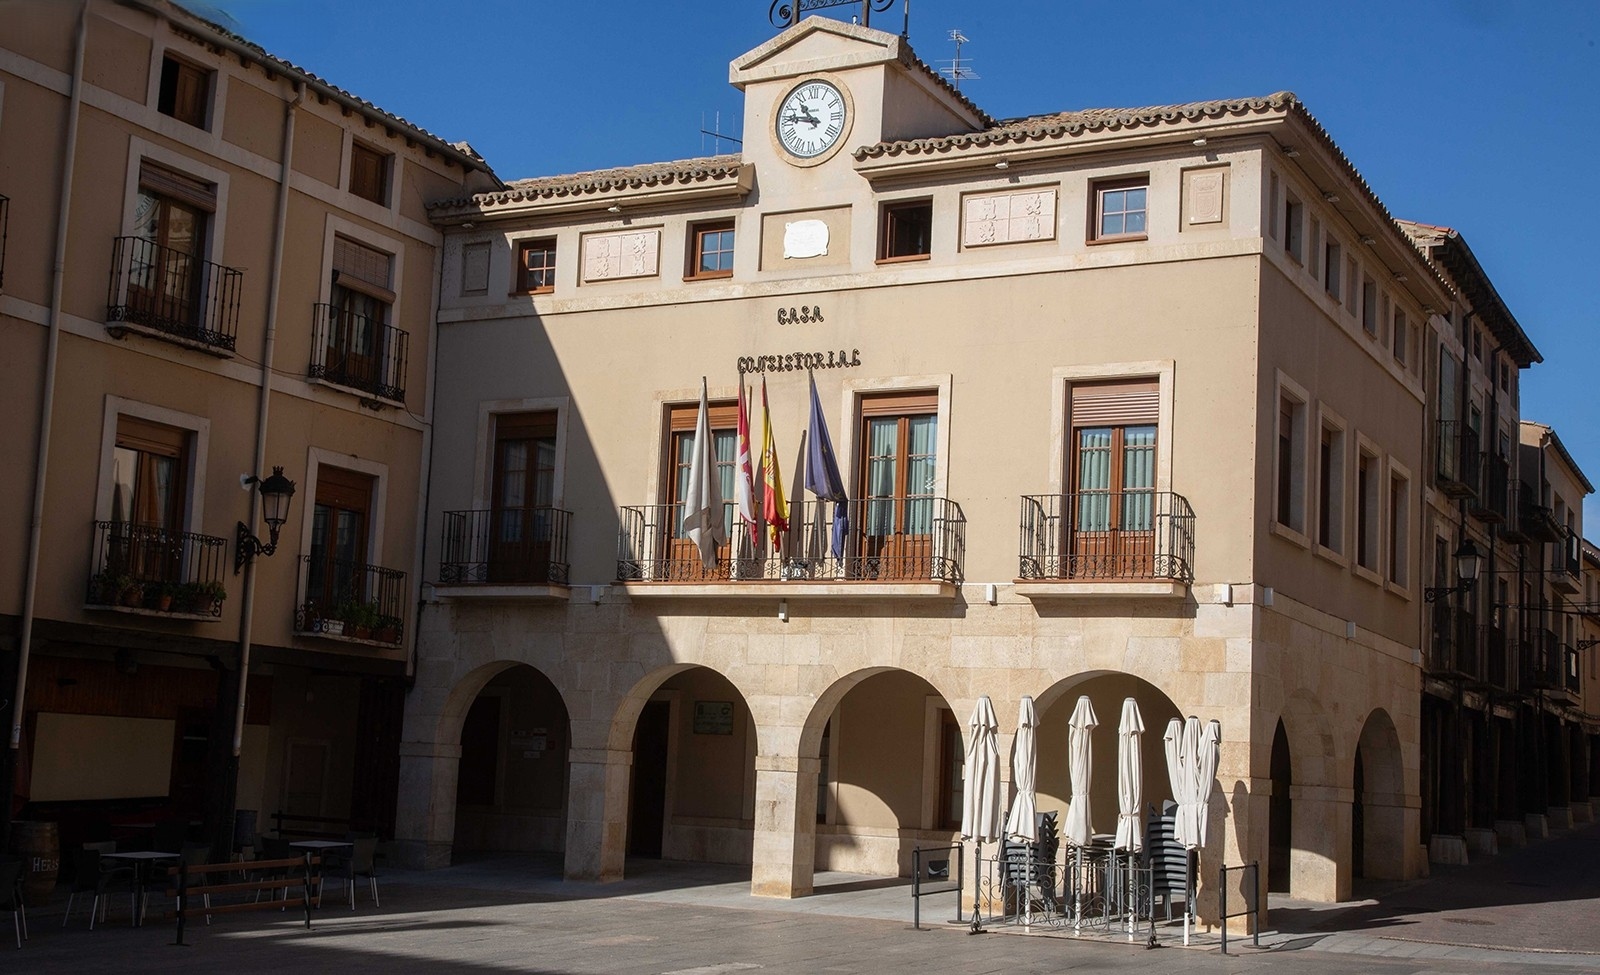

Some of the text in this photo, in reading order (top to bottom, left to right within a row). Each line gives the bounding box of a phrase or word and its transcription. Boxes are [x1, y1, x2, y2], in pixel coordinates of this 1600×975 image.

[808, 88, 819, 100] XII
[828, 98, 840, 109] II
[830, 111, 841, 121] III
[785, 127, 798, 145] VIII
[824, 124, 838, 138] IIII
[794, 137, 806, 152] VII
[819, 137, 828, 148] V
[777, 305, 825, 325] CASA
[737, 348, 862, 374] CONSISTORIAL
